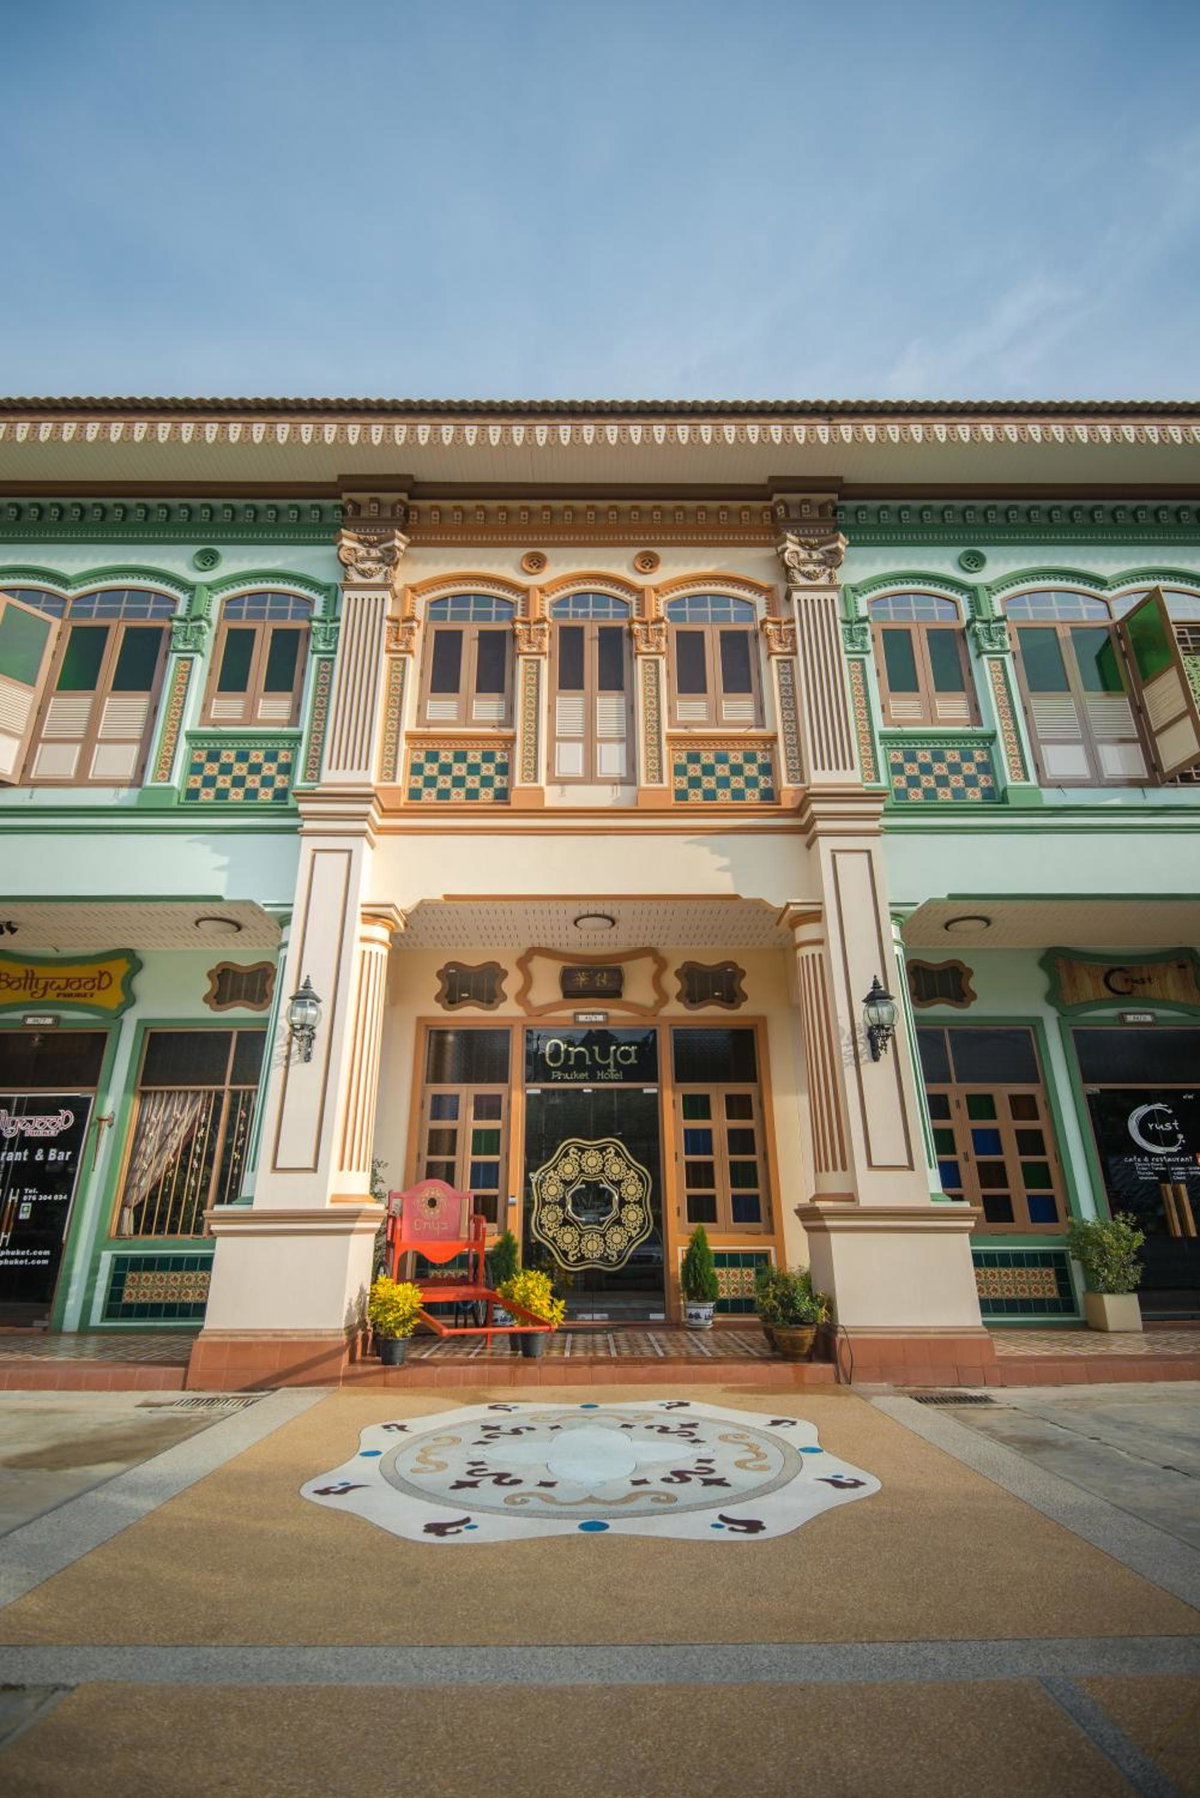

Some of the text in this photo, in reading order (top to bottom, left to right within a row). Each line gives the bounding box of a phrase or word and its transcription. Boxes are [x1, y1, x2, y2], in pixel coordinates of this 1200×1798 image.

[545, 1039, 638, 1072] Onya
[551, 1070, 623, 1080] Phuket Hotel
[35, 1148, 44, 1161] &
[48, 1148, 72, 1161] Bar
